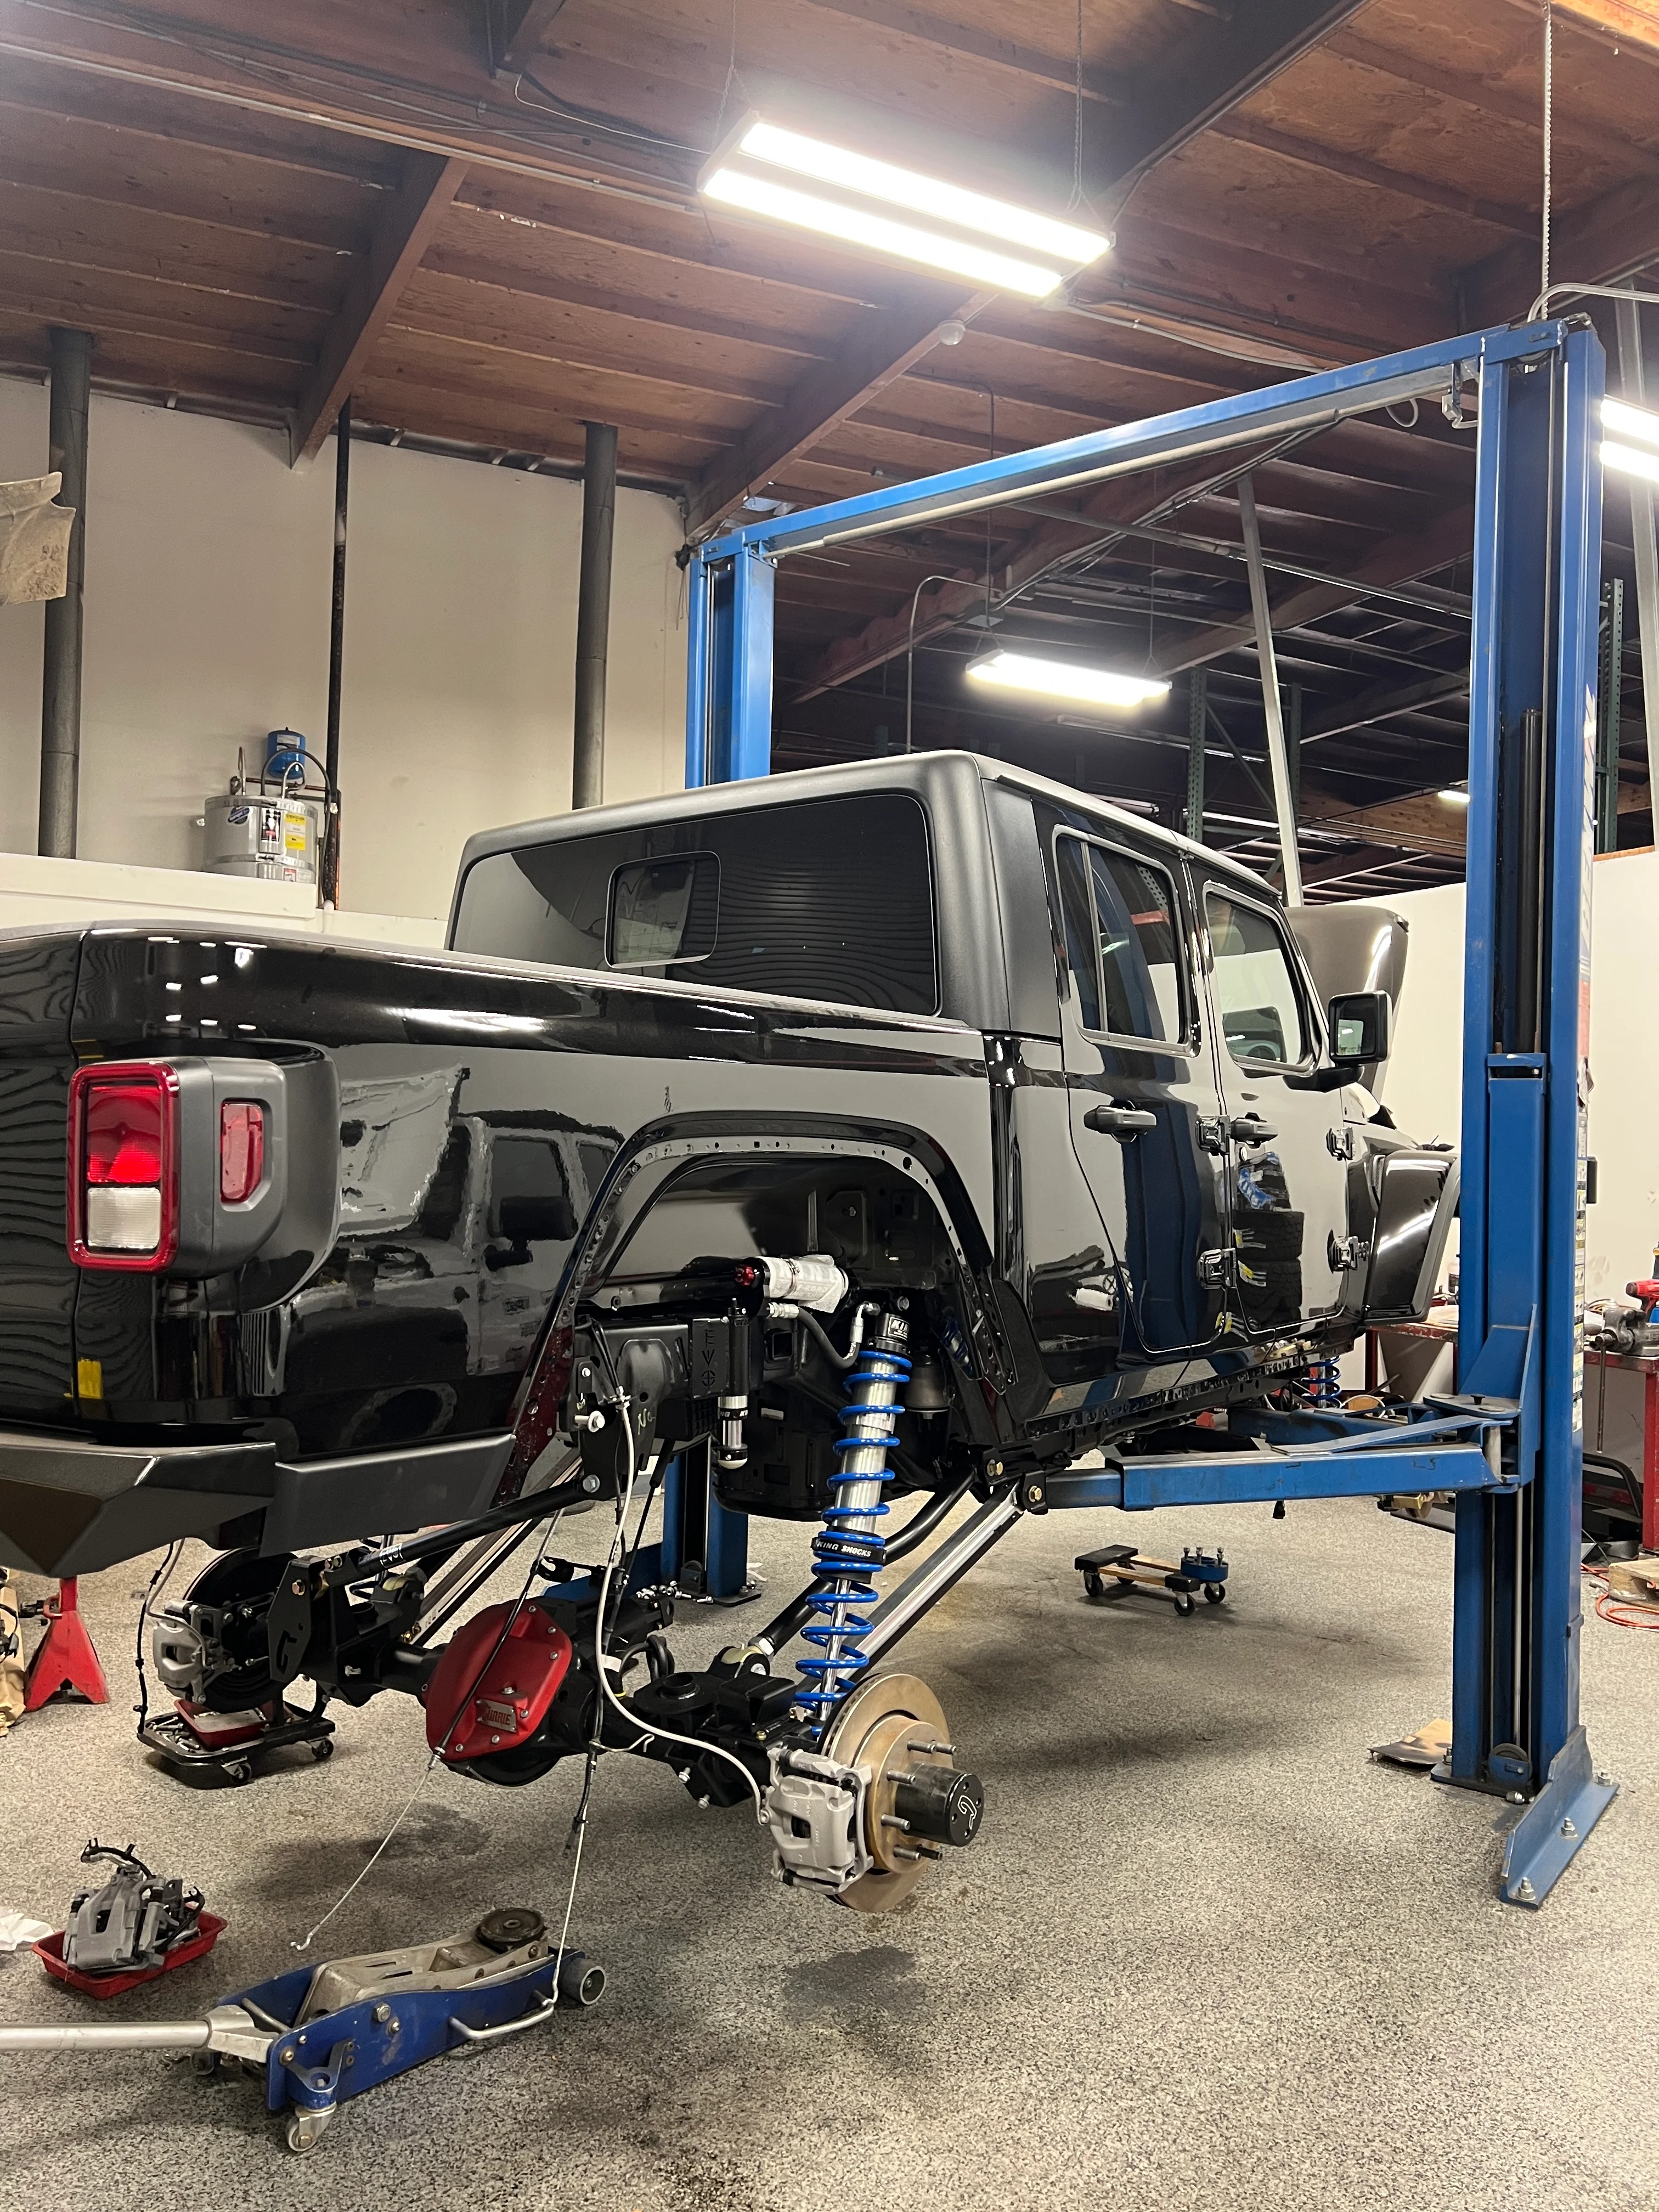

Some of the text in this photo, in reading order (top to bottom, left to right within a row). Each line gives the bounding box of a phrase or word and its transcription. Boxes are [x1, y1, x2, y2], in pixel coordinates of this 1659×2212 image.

[816, 1541, 872, 1557] KING SHOCKS
[484, 1705, 512, 1725] URRIE
